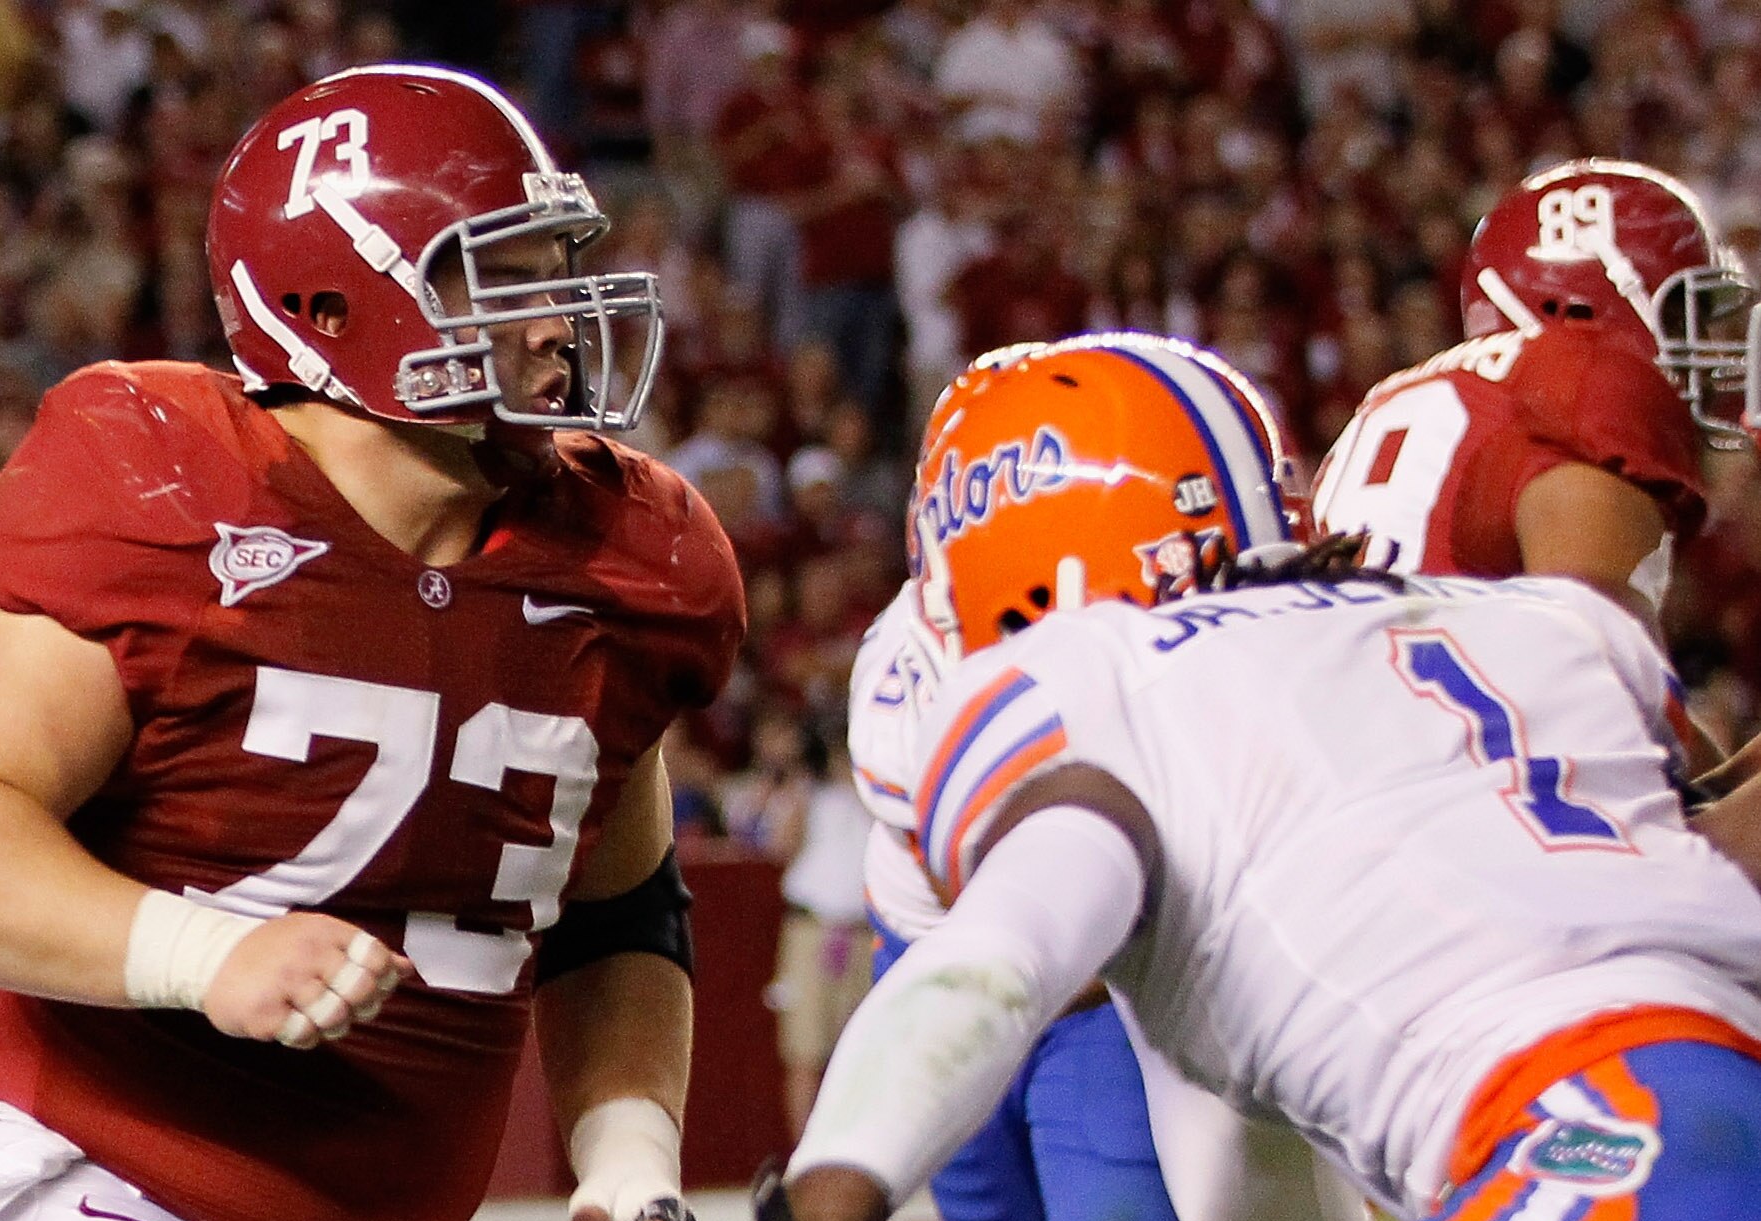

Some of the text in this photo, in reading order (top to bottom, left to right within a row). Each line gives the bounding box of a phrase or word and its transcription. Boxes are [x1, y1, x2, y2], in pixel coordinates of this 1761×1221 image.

[276, 107, 371, 220] 73
[1537, 184, 1616, 262] 89
[236, 547, 282, 570] SEC
[1386, 627, 1644, 854] 1
[183, 665, 600, 996] 73
